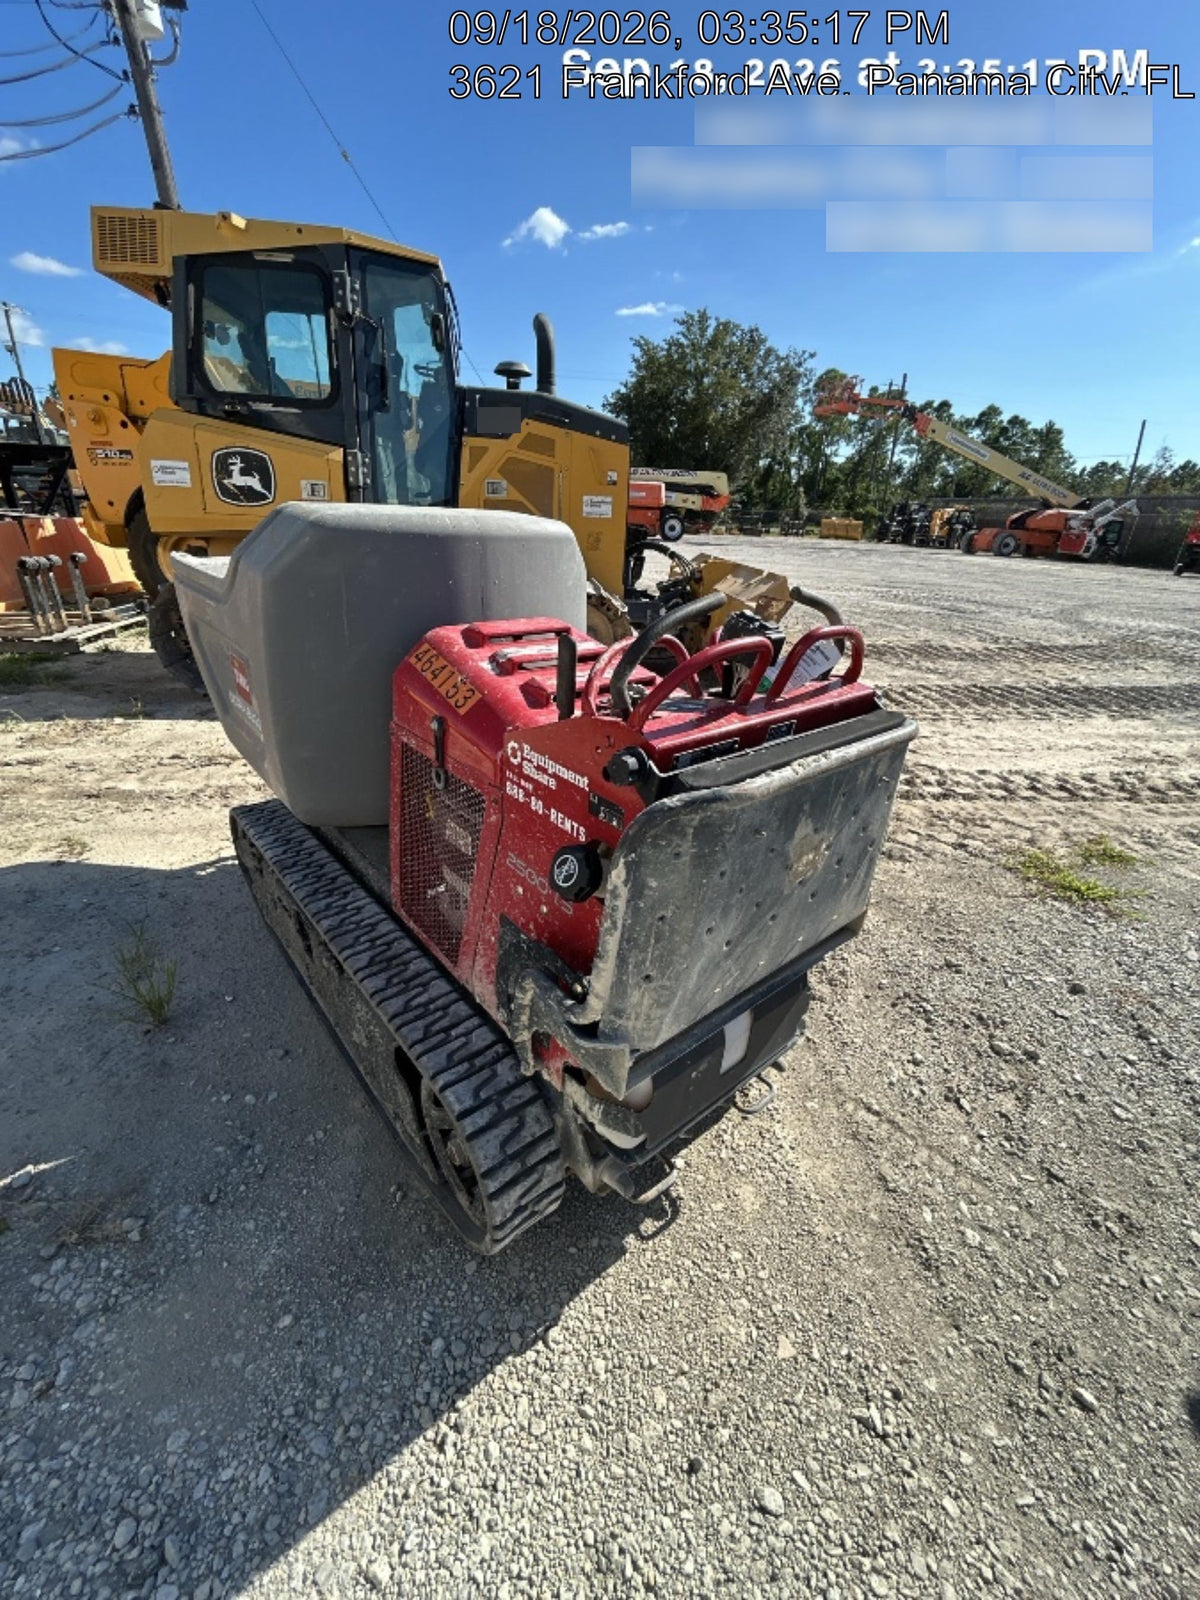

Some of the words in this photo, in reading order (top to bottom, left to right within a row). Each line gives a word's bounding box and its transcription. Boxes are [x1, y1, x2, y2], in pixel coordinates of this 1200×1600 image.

[413, 648, 476, 709] 464153
[522, 743, 589, 792] Equipment
[522, 760, 557, 790] Share
